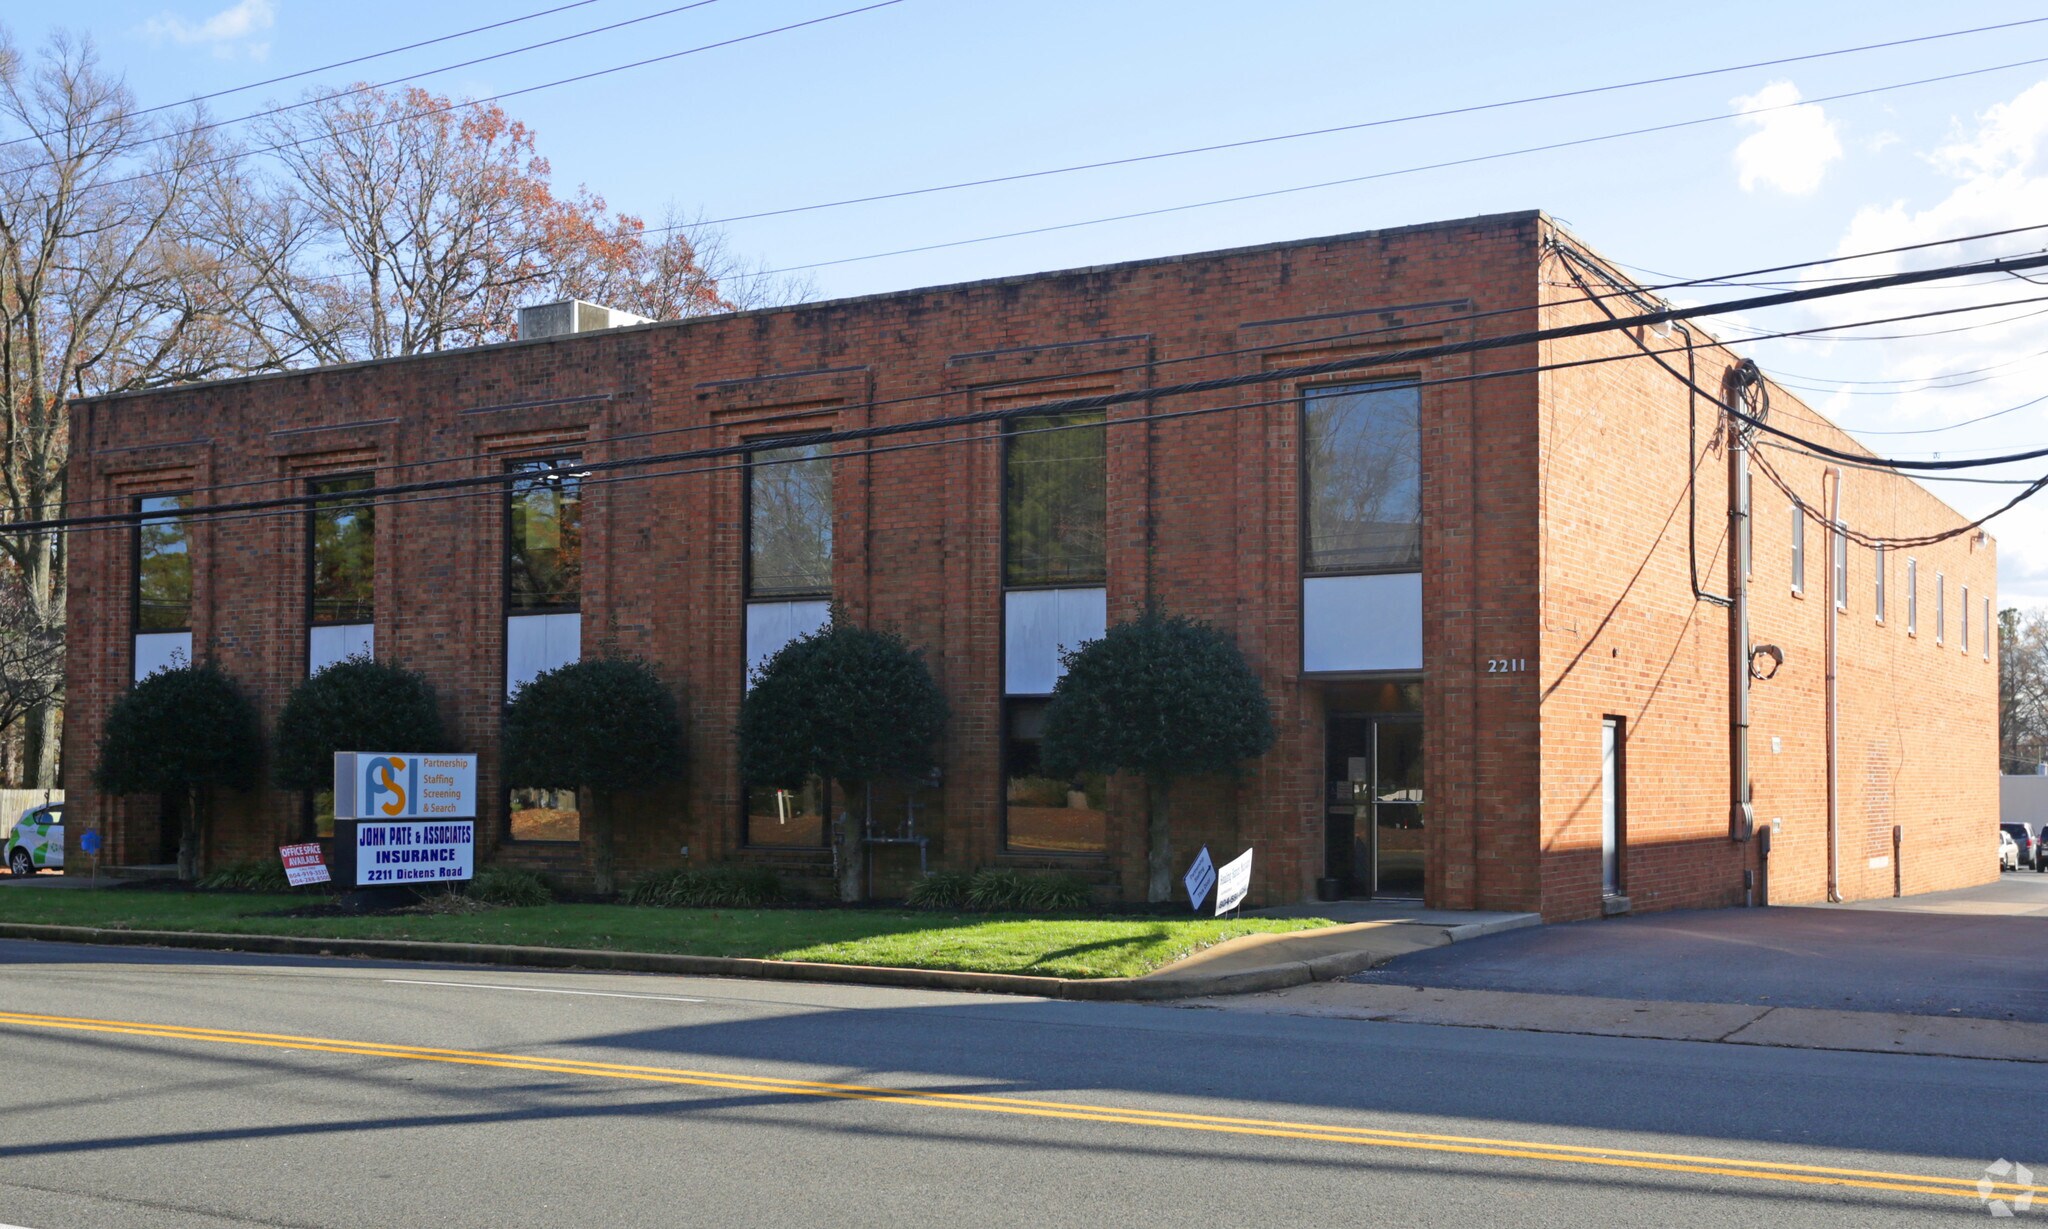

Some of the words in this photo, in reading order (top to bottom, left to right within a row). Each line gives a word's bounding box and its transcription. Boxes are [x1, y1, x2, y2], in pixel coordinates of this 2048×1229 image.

[1488, 658, 1526, 673] 2211
[423, 757, 468, 769] Partnership
[365, 756, 418, 816] PSI
[423, 774, 454, 787] Staffing
[423, 788, 461, 800] Screening
[423, 803, 429, 813] &
[431, 802, 456, 813] Search
[359, 826, 385, 847] JOHN
[390, 826, 412, 846] PATE
[415, 831, 421, 844] &
[423, 825, 471, 845] ASSOCIATES
[281, 846, 304, 857] OFFICE
[303, 844, 321, 855] SPACE
[376, 848, 456, 864] INSURANCE
[288, 855, 320, 867] AVAILABLE
[367, 869, 393, 881] 2211
[396, 868, 436, 880] Dickens
[439, 866, 463, 878] Road
